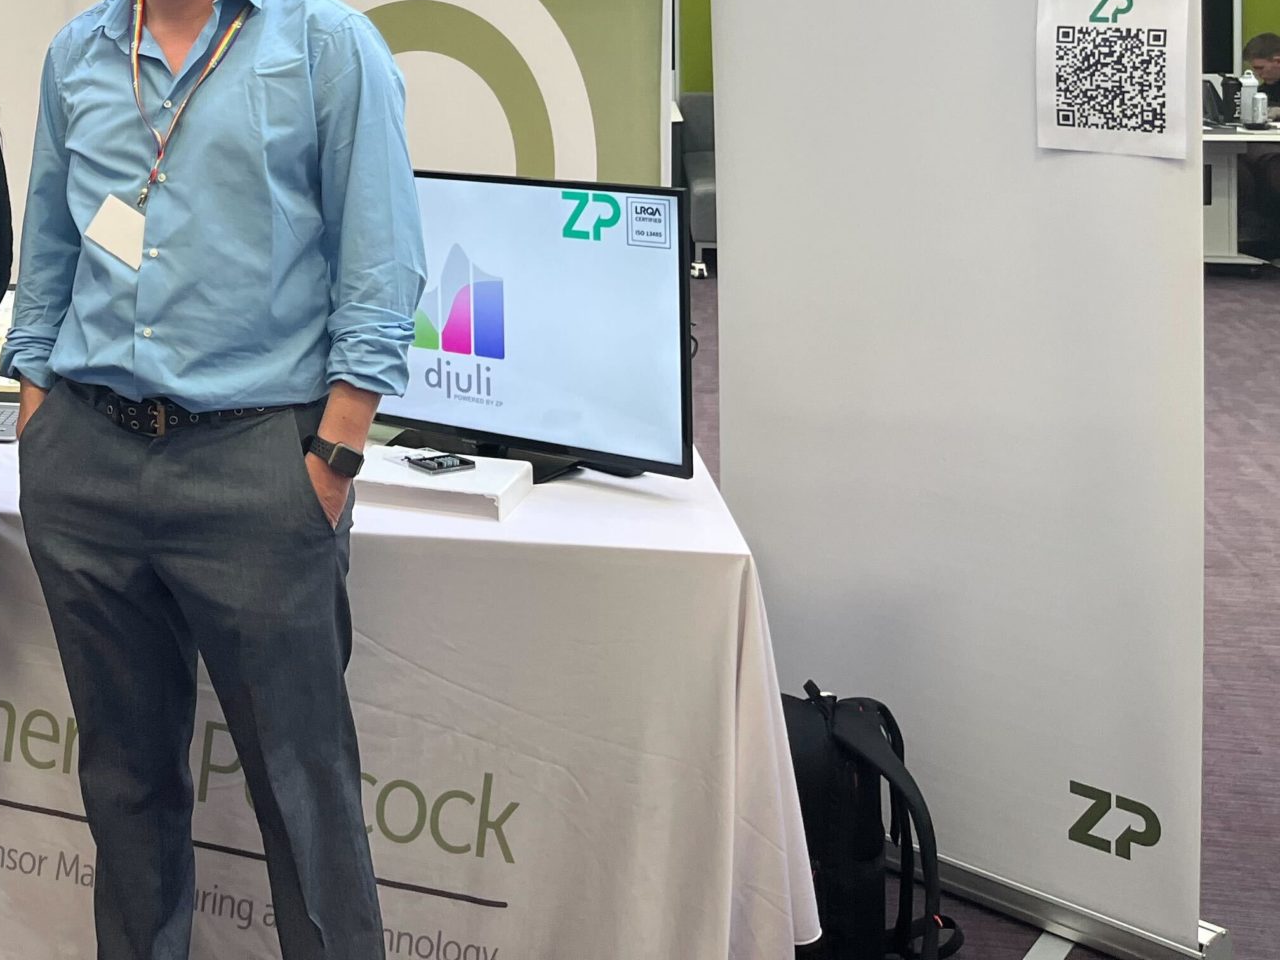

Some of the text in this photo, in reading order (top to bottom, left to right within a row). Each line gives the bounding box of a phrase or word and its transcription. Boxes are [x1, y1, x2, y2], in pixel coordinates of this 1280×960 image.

[561, 191, 621, 240] ZP
[635, 205, 661, 216] LRQA
[635, 216, 662, 224] CERTIFIED
[425, 357, 491, 399] djuli
[454, 394, 484, 405] POWERED
[485, 398, 494, 406] BY
[197, 720, 520, 864] Pock
[1068, 780, 1161, 861] ZP
[382, 927, 499, 960] nology
